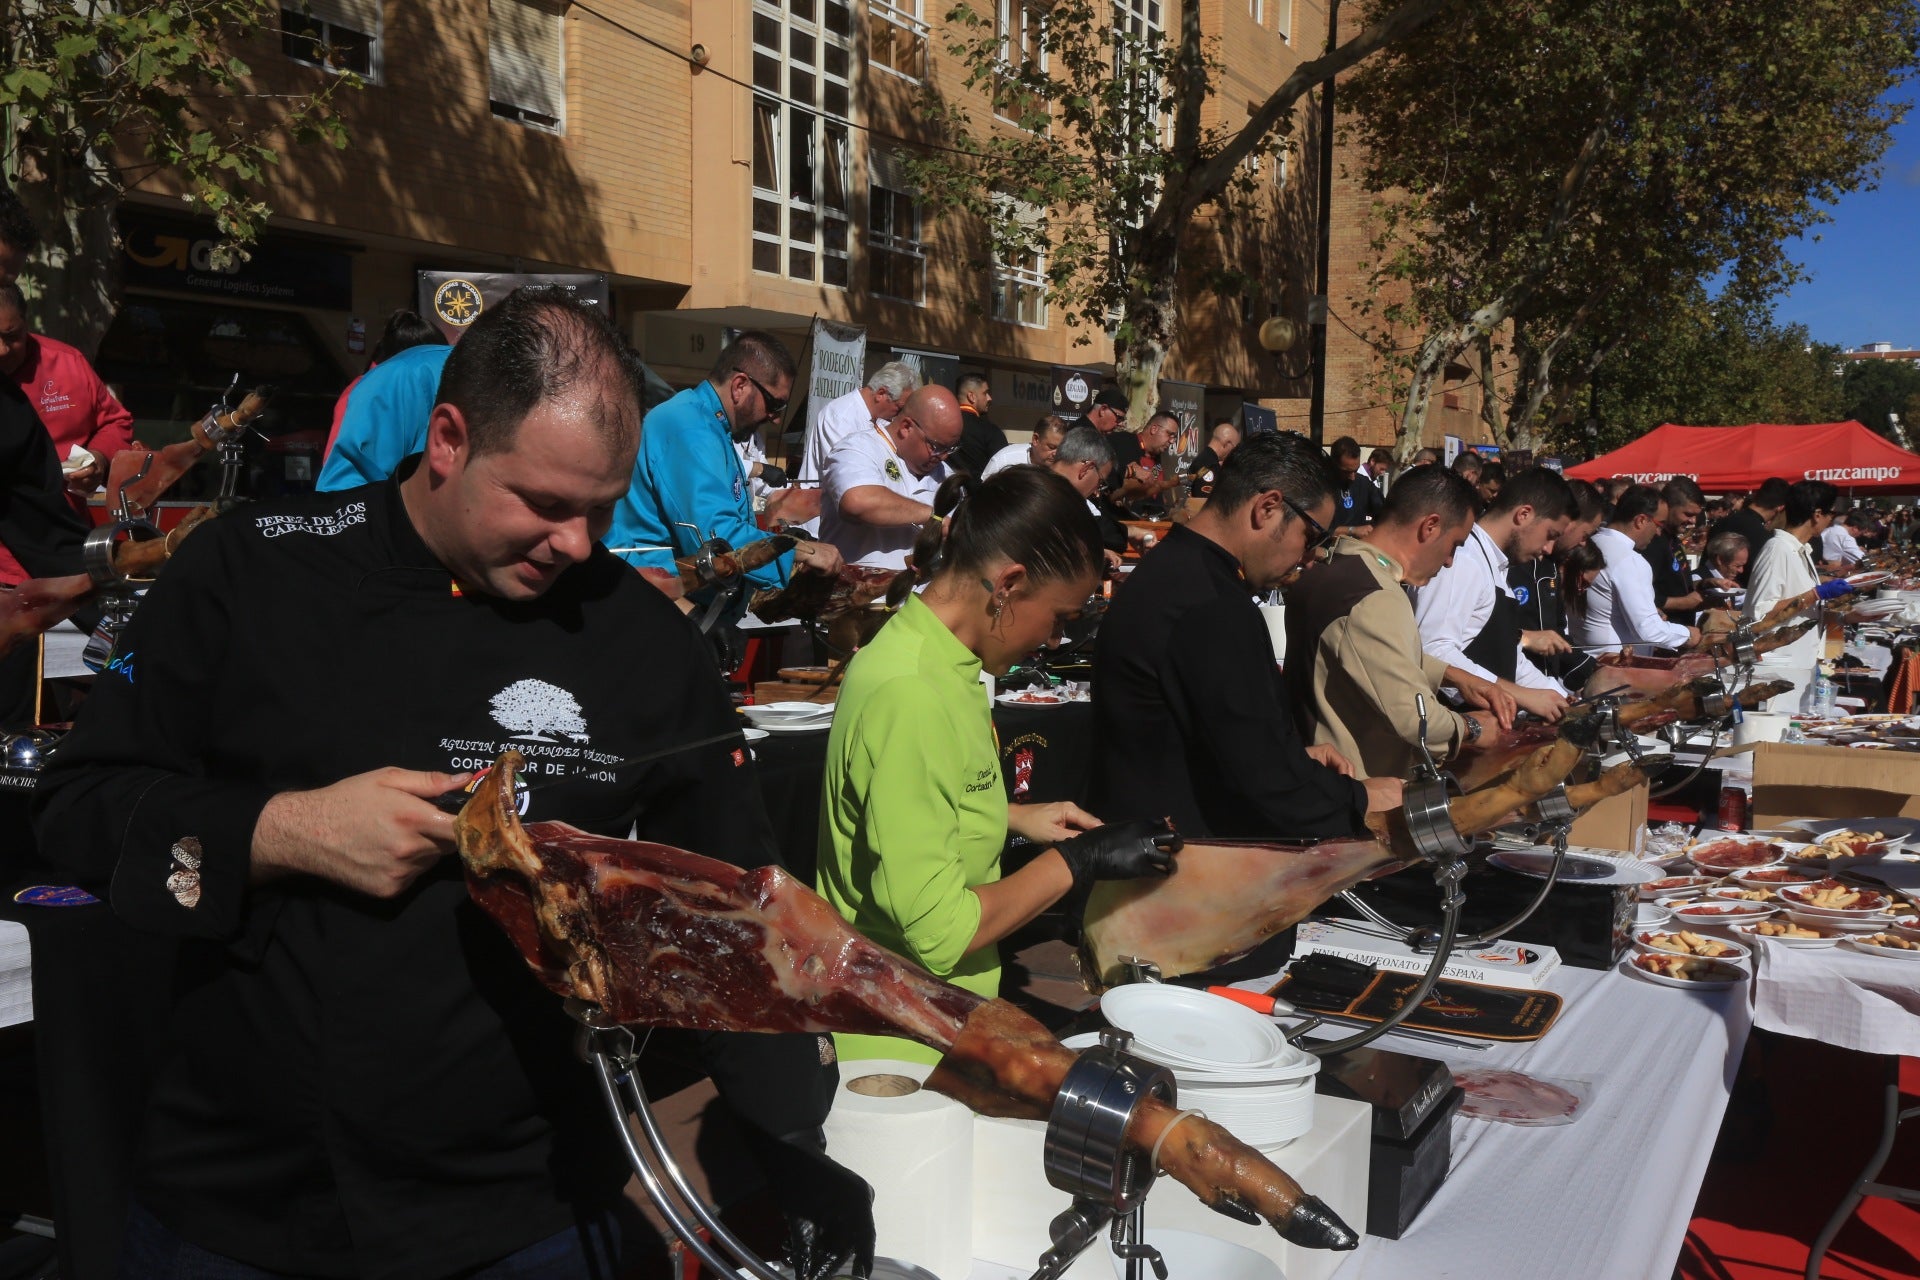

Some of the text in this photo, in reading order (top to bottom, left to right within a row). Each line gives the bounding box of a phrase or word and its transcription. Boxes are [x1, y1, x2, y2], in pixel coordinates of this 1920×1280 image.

[190, 239, 242, 275] GS
[187, 274, 295, 297] General Logistics Systems
[691, 333, 705, 352] 19
[255, 502, 366, 528] JEREZ DE LOS
[263, 513, 366, 538] CABALLEROS
[451, 757, 538, 774] CORTOR
[546, 763, 565, 776] DE
[583, 748, 625, 765] VÁZQUE
[1311, 947, 1341, 958] FINAL
[1345, 952, 1420, 970] CAMPEONATO
[1442, 966, 1485, 981] ESPAÑA
